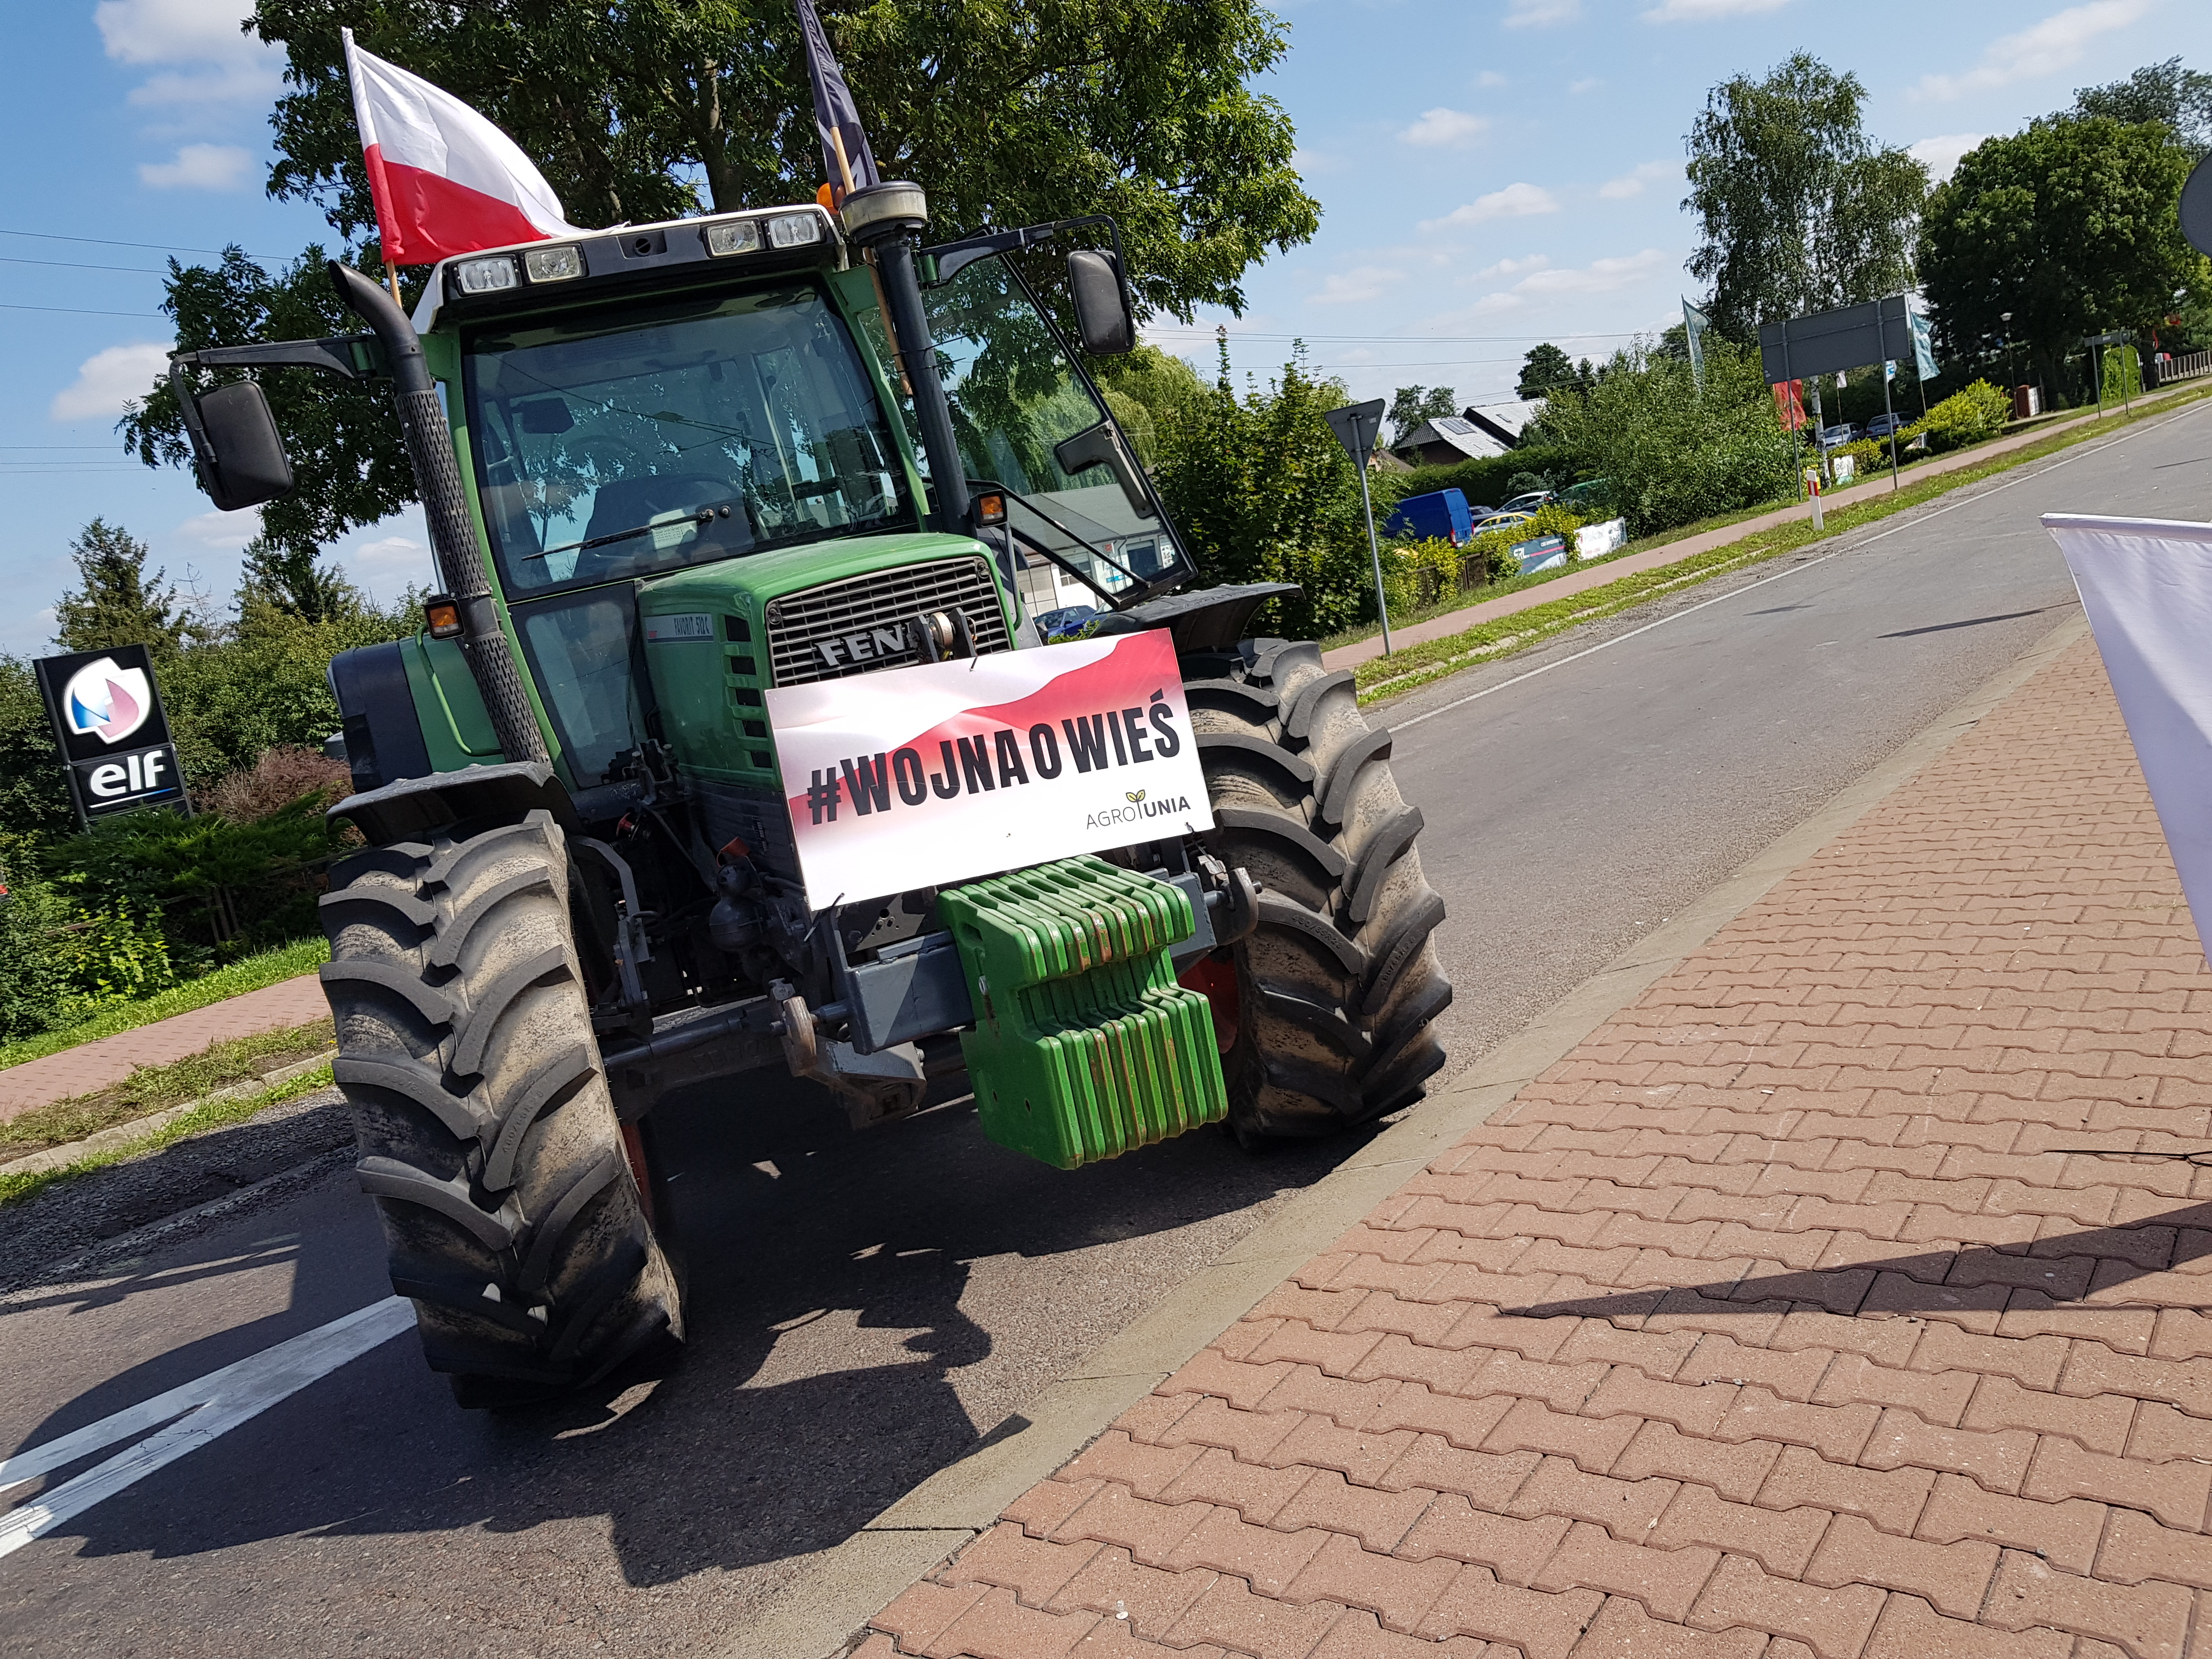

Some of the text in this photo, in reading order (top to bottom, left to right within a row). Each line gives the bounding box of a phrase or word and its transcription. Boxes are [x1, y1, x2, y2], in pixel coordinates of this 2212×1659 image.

[674, 616, 695, 636] FAVORIT
[814, 623, 910, 667] FEN
[90, 749, 164, 797] elf
